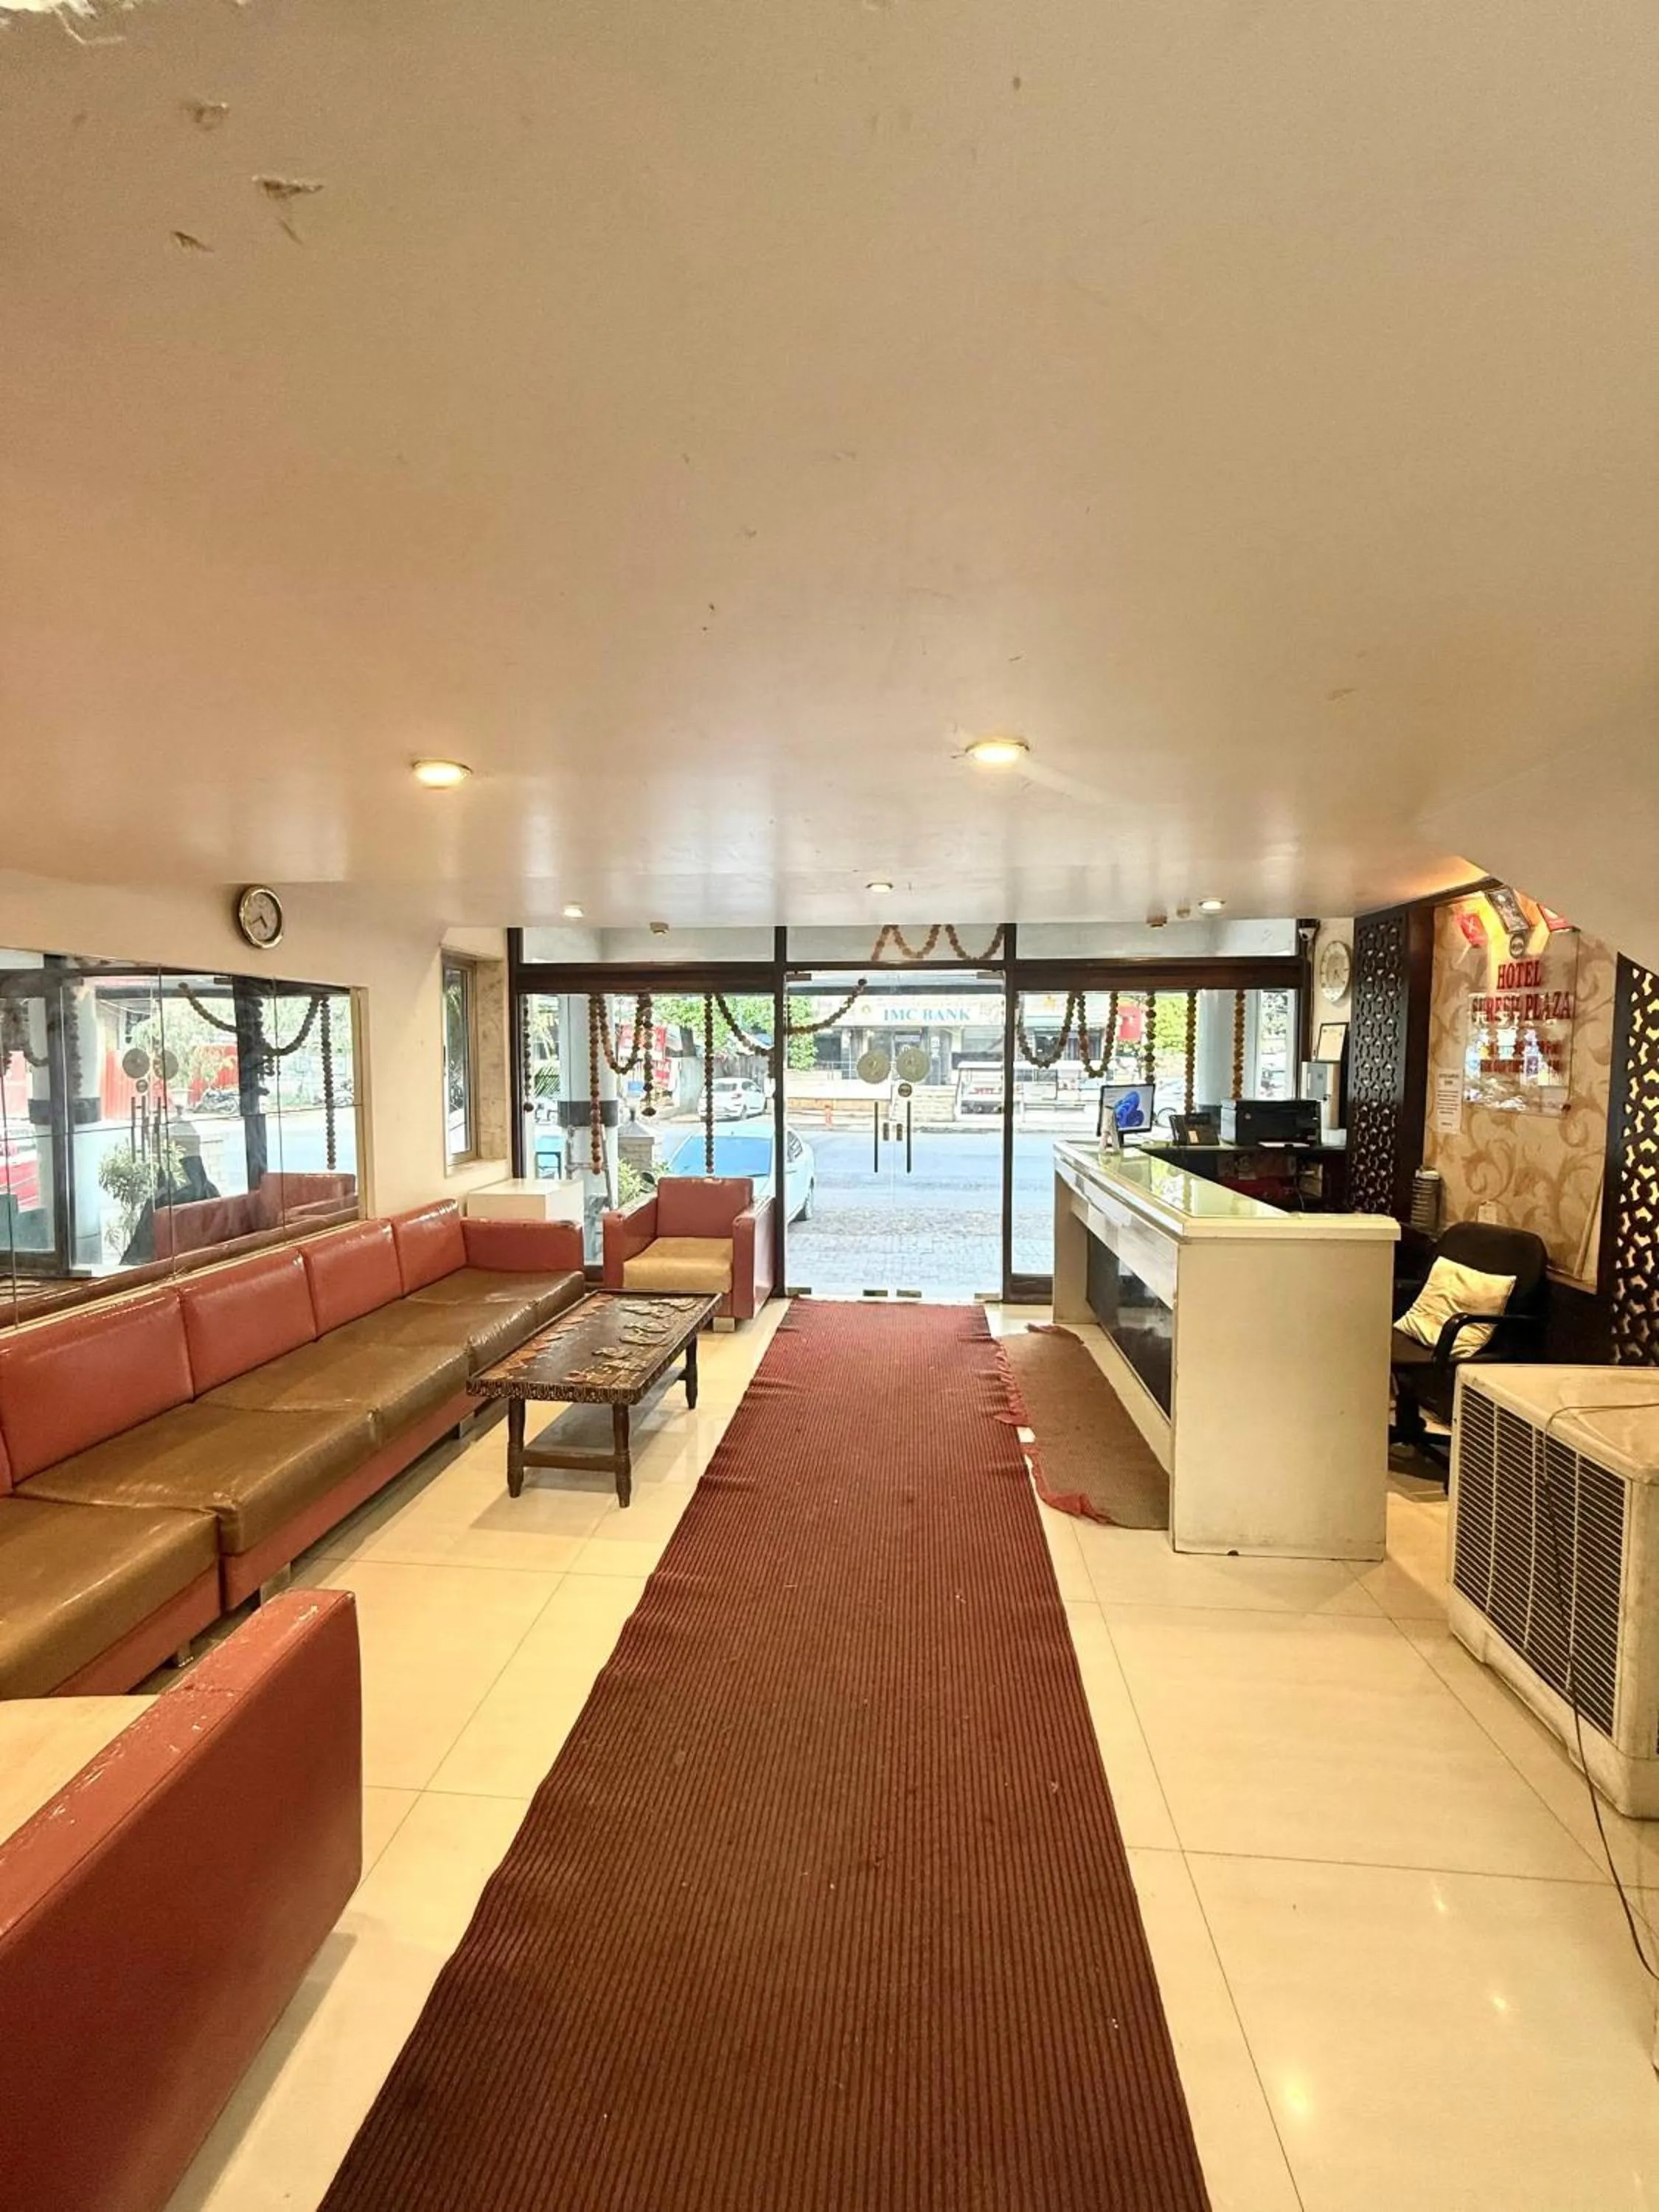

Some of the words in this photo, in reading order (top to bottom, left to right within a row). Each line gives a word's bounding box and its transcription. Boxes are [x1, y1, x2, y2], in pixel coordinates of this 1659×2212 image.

[1497, 960, 1542, 990] HOTEL
[922, 1008, 971, 1021] BANK
[1524, 991, 1571, 1020] PLAZA
